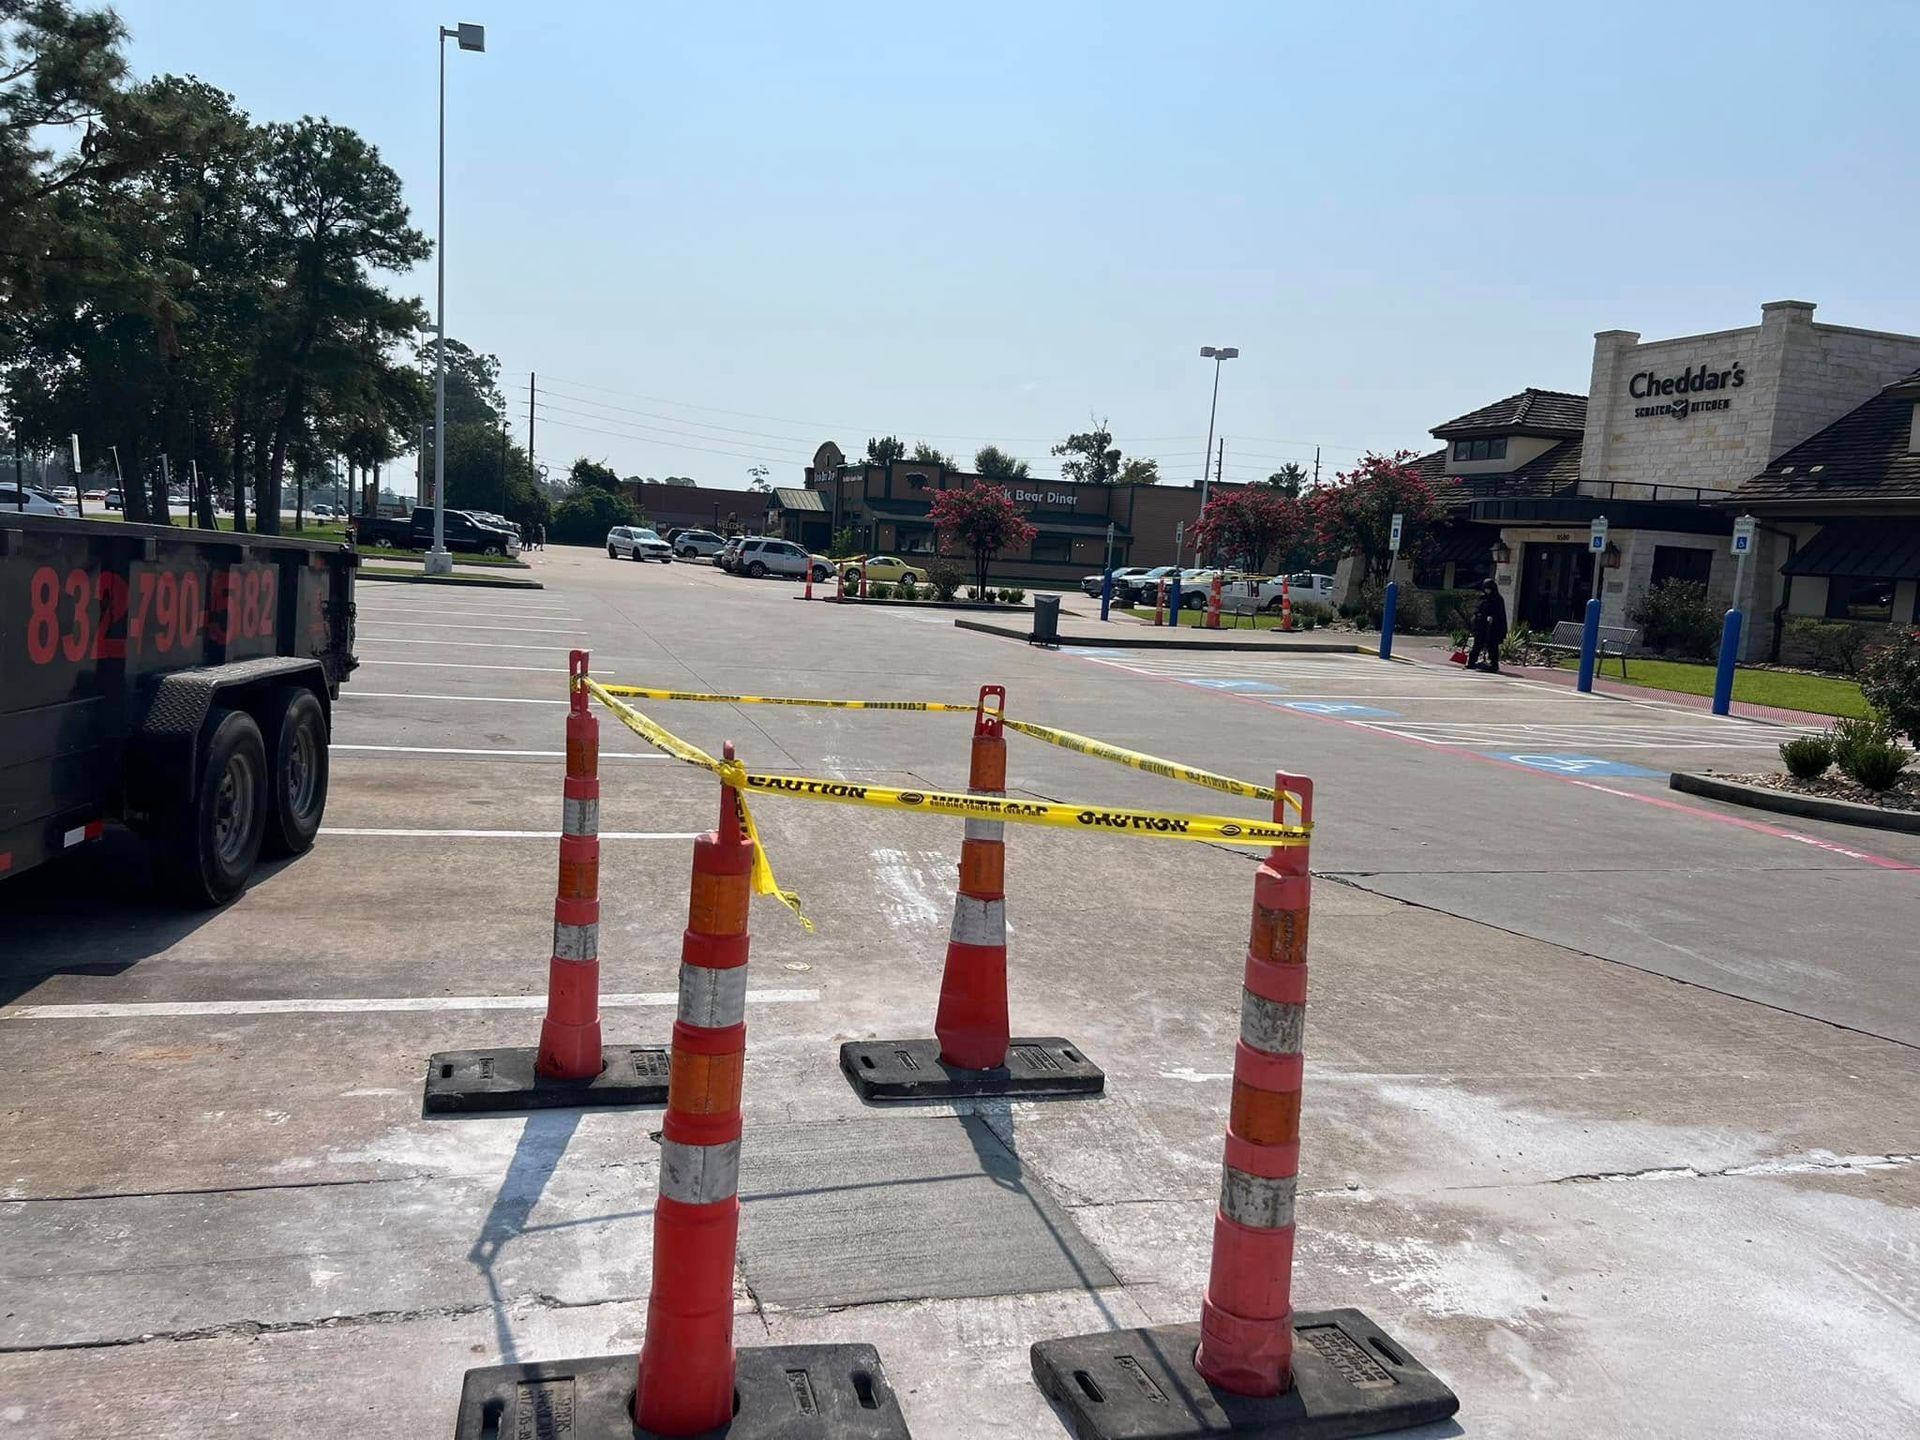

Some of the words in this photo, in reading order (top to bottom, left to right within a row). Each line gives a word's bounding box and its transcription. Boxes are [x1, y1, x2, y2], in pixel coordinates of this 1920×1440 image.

[1629, 361, 1745, 399] Cheddar's
[1015, 489, 1043, 502] Bear
[1047, 491, 1078, 505] Diner
[746, 775, 868, 799] CAUTION
